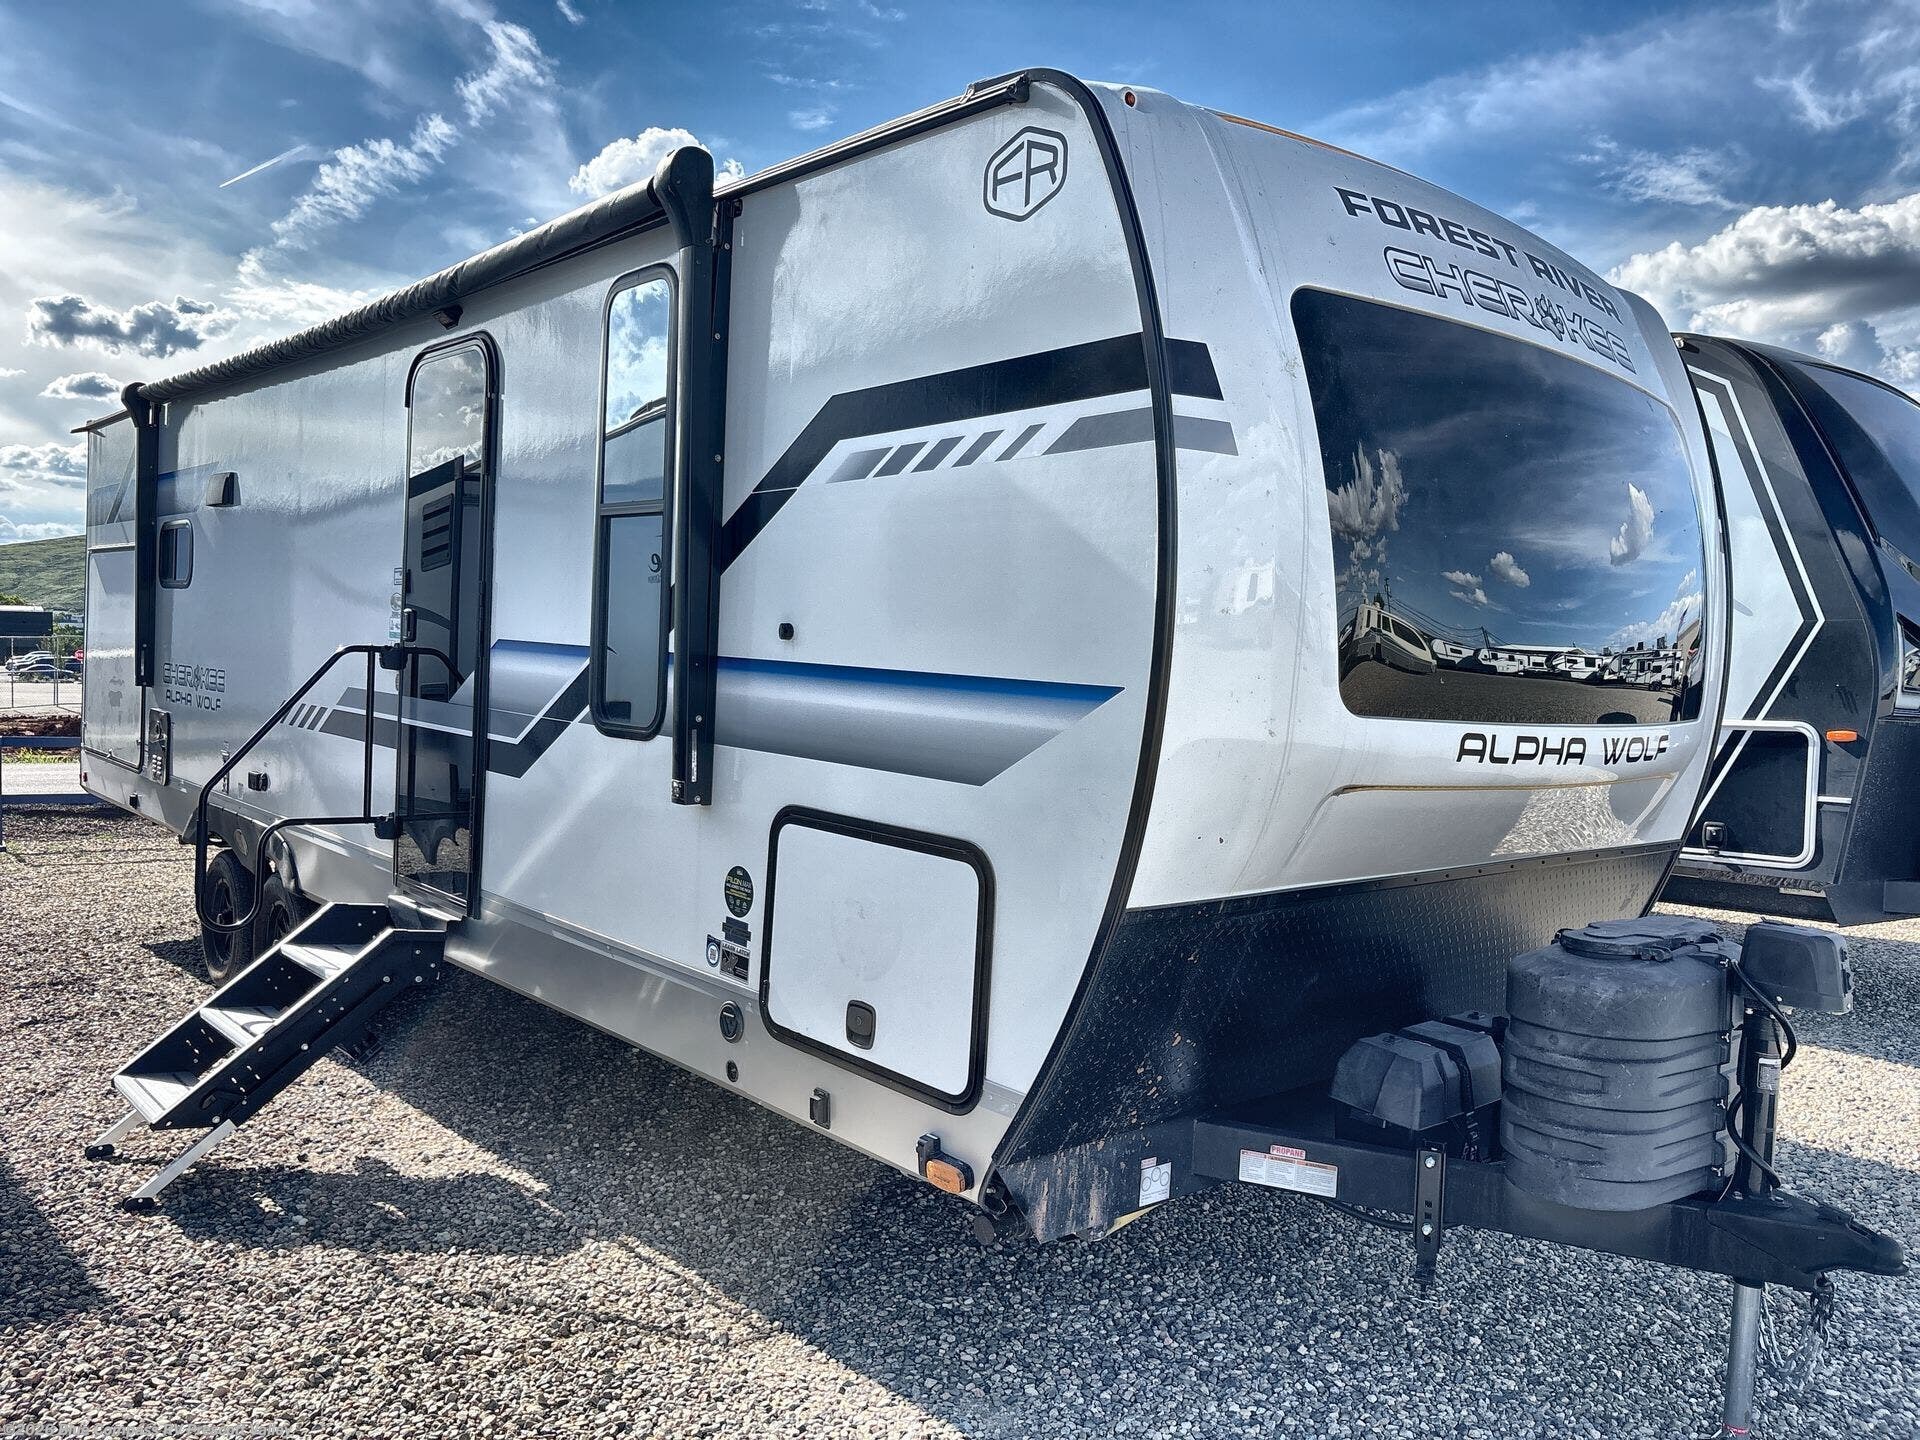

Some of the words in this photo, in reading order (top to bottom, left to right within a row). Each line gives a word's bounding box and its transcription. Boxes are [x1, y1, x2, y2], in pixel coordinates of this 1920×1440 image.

[1333, 186, 1519, 268] FOREST
[1523, 251, 1624, 325] RIVER
[165, 689, 192, 706] ALPHA
[196, 694, 222, 711] WOLF
[1456, 732, 1587, 765] ALPHA
[1602, 734, 1669, 765] WOLF
[1271, 1145, 1305, 1158] PROPANE
